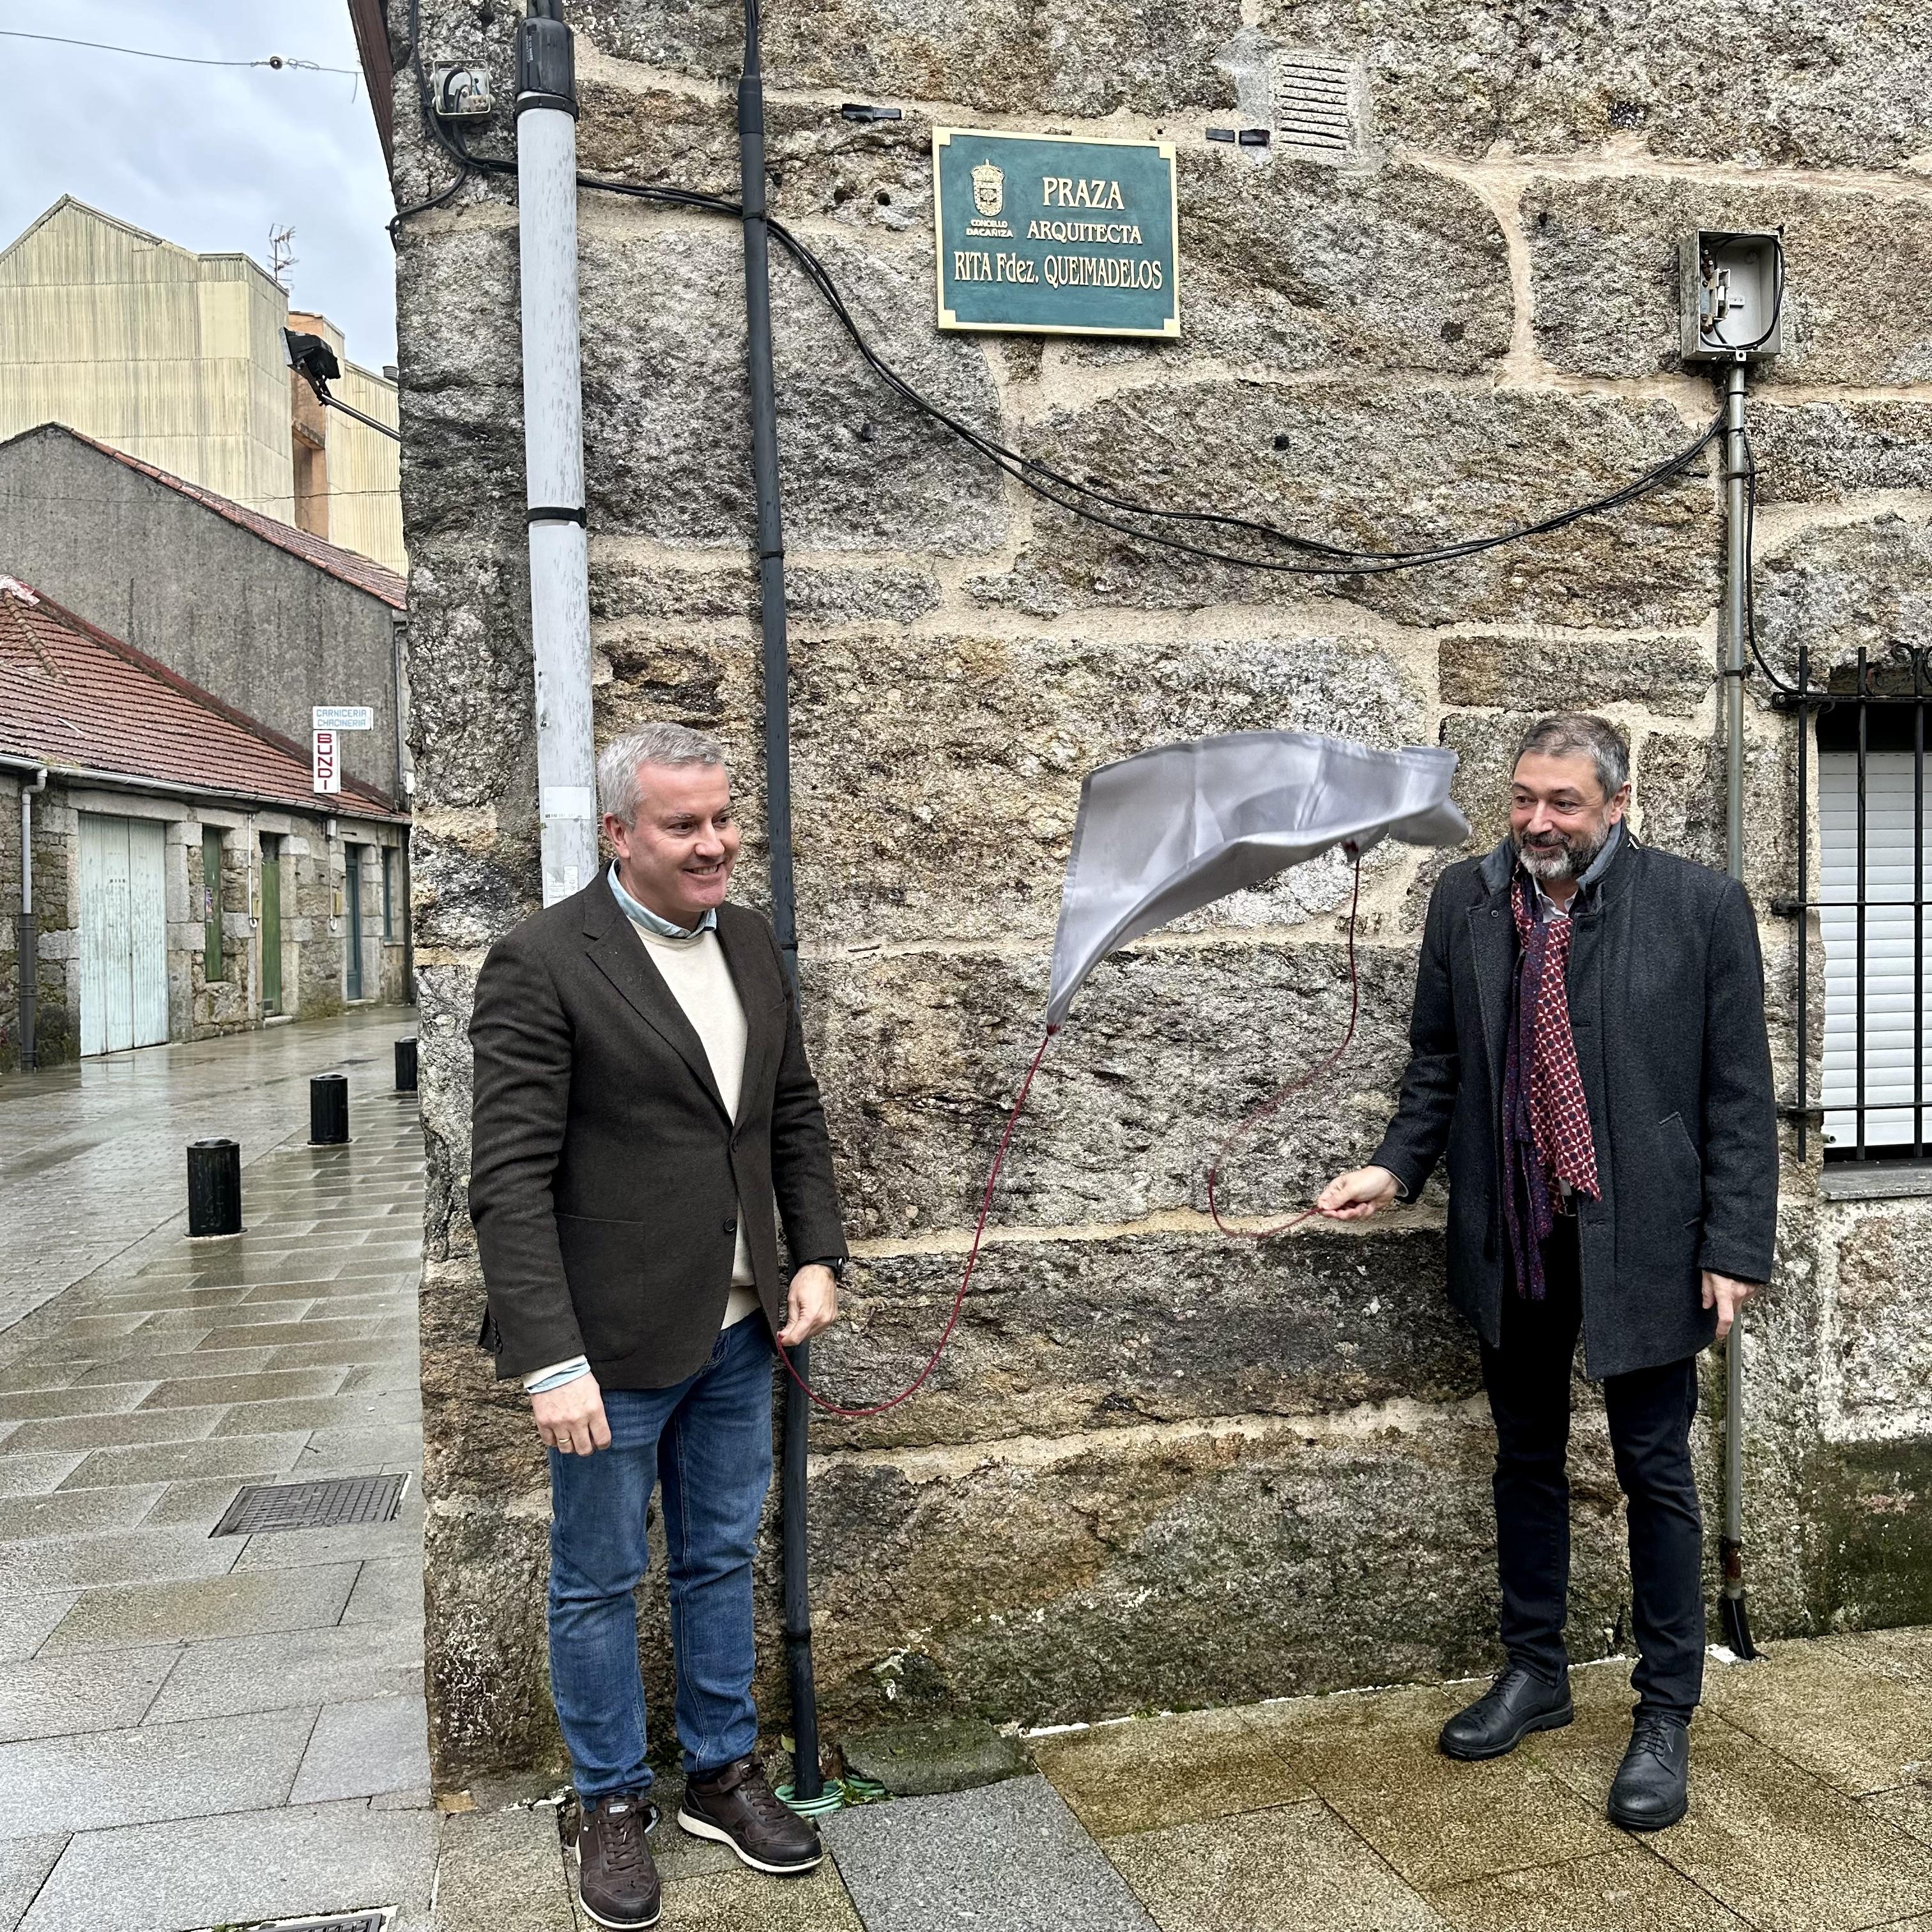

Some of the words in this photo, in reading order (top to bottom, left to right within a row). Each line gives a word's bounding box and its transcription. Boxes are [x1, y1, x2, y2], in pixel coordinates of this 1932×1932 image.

[1042, 177, 1125, 210] PRAZA
[970, 219, 1008, 229] CONCELLO
[1027, 220, 1143, 245] ARQUITECTA
[954, 251, 993, 282] RITA
[996, 252, 1039, 284] Fdez.
[1045, 255, 1163, 291] QUEIMADELOS
[316, 709, 367, 717] CARNICERIA
[318, 719, 366, 727] CHACINERIA
[317, 733, 333, 790] BUNDI
